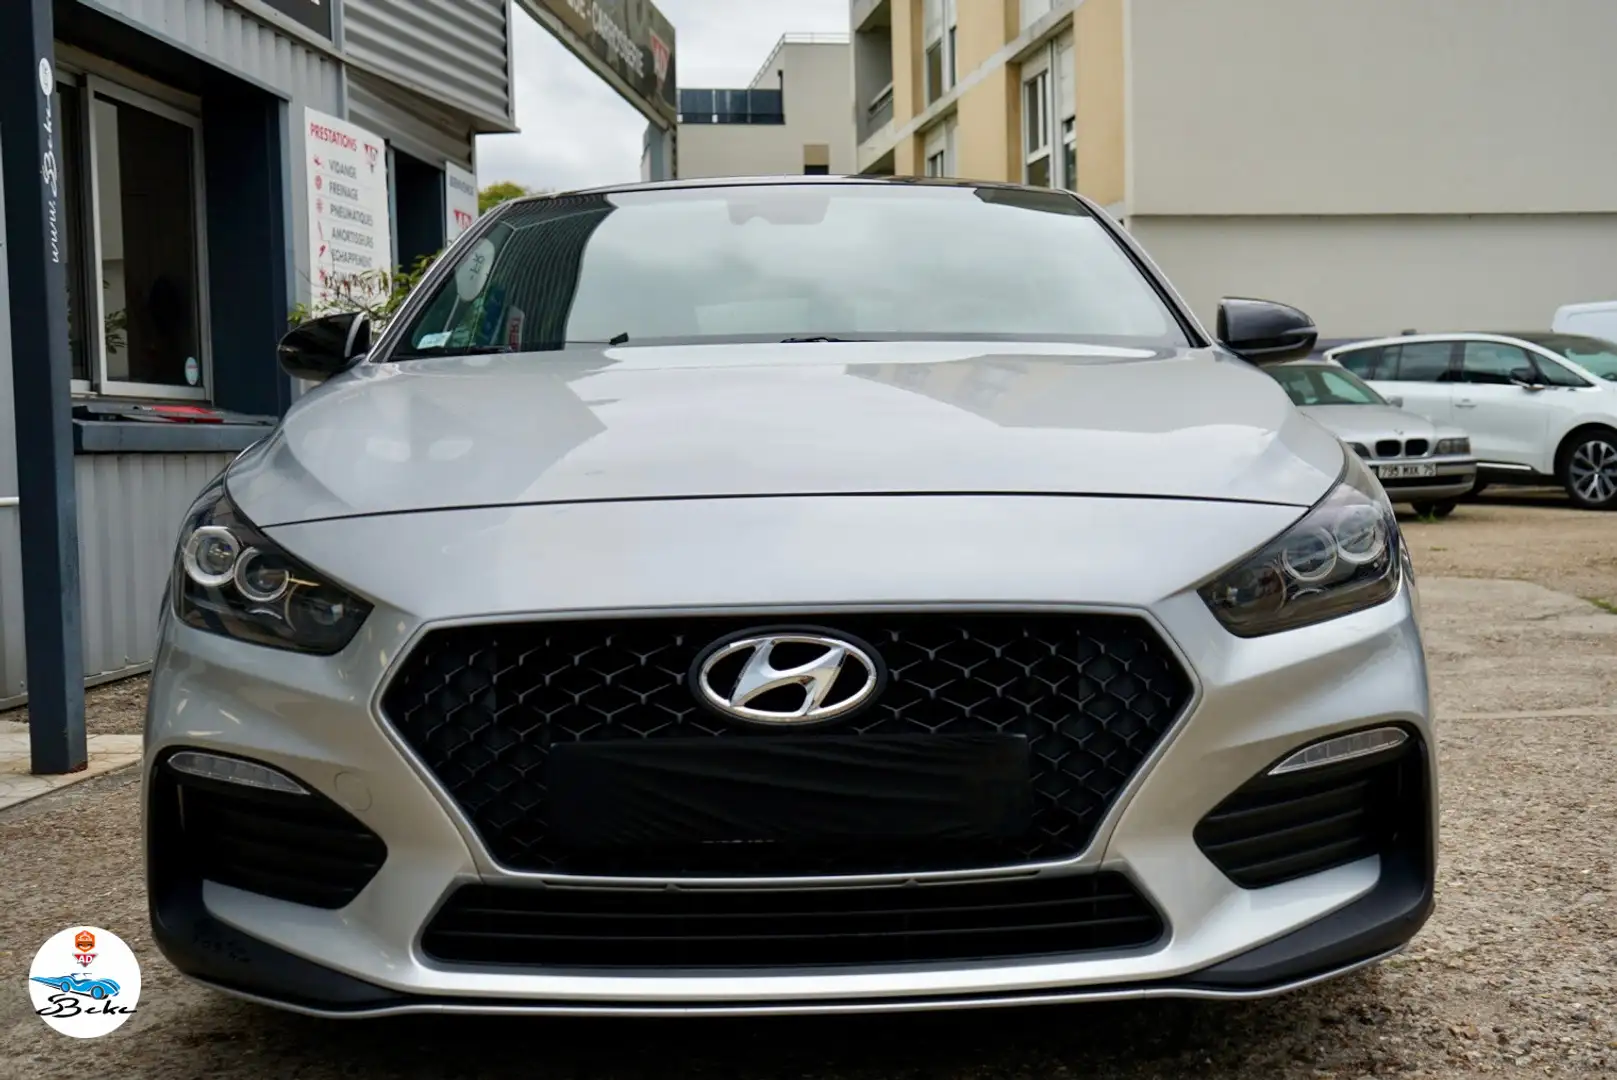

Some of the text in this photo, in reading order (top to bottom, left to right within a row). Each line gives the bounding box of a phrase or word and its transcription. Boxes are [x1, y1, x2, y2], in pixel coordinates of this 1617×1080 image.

[310, 122, 357, 152] PRESTATIONS
[328, 159, 357, 179] VIDANGE
[329, 181, 359, 201] FREINAGE
[330, 203, 373, 227] PNEUMATIQUES
[331, 226, 374, 249] AMORTISSEURS
